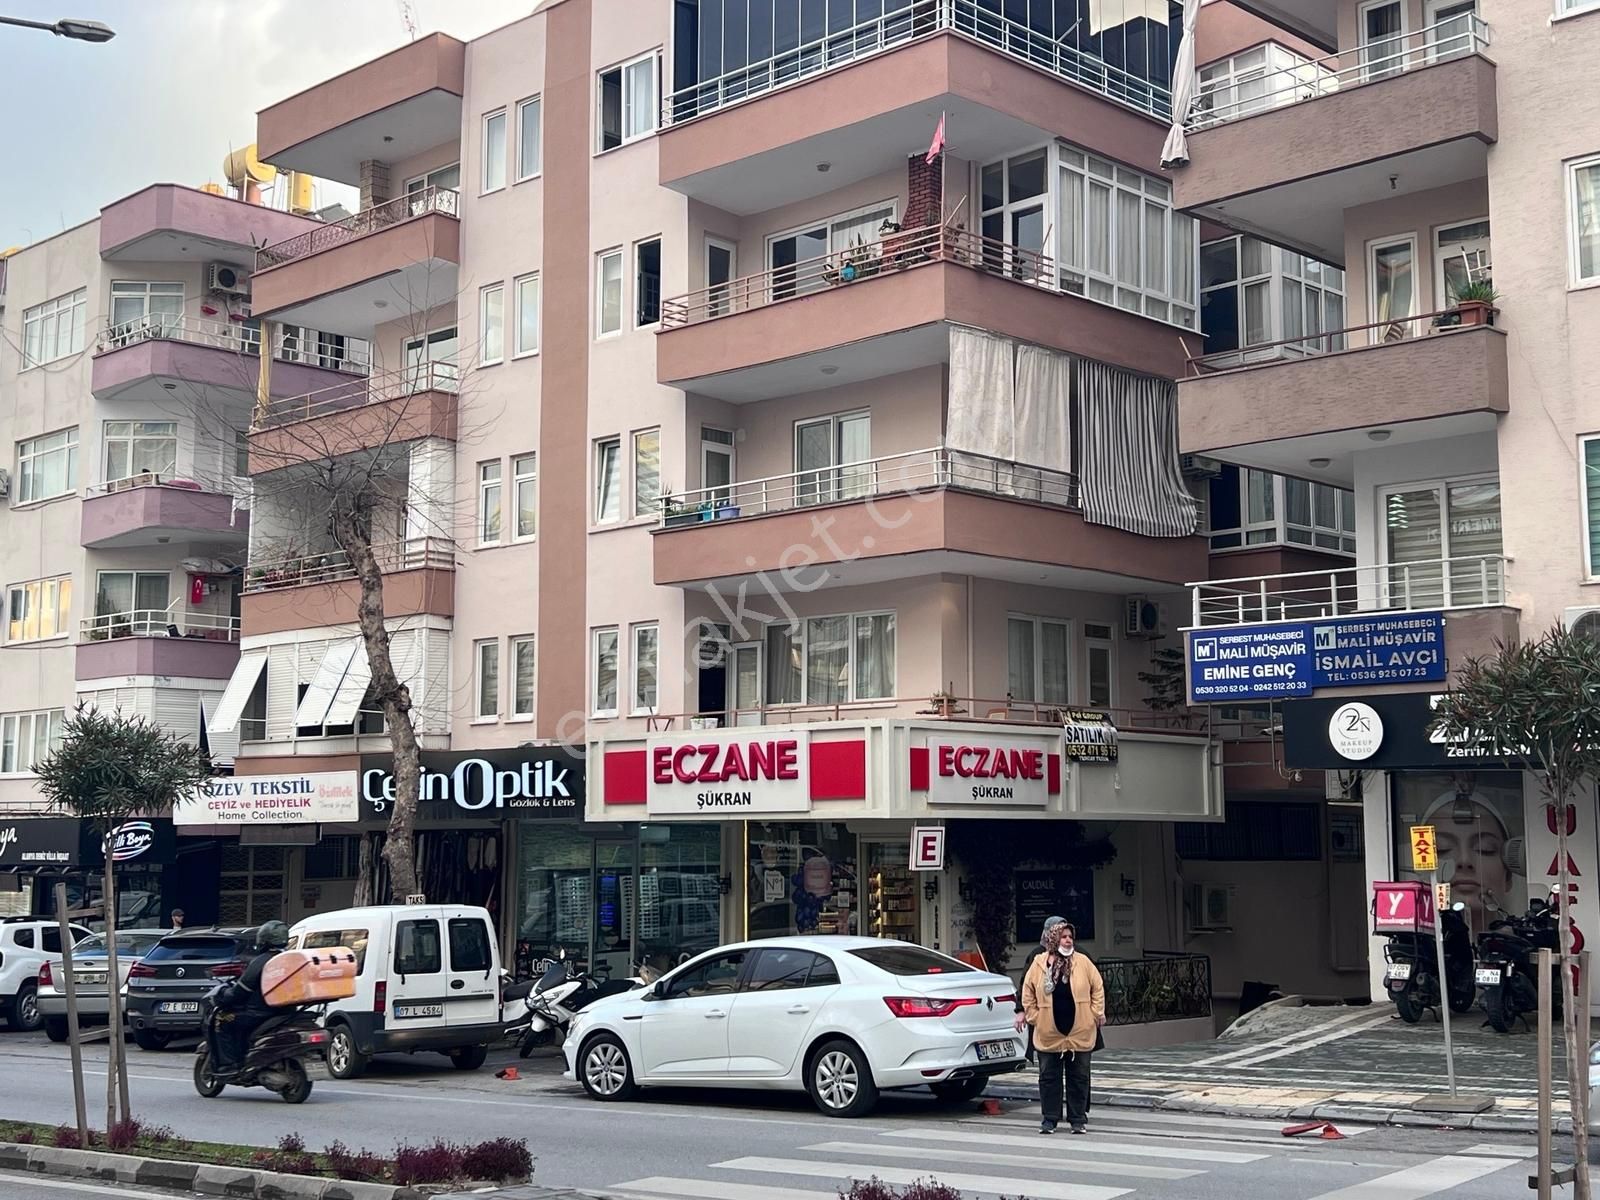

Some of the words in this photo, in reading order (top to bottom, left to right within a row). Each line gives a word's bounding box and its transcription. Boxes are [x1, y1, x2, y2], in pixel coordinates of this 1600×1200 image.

[1337, 623, 1376, 634] SERBEST
[1377, 618, 1436, 631] MUHASEBECİ
[1220, 634, 1252, 645] SERBEST
[1253, 630, 1304, 642] MUHASEBECİ
[1338, 633, 1371, 648] MALİ
[1373, 629, 1436, 646] MÜŞAVİR
[1220, 645, 1249, 660] MALİ
[1251, 642, 1306, 659] MÜŞAVİR
[1315, 650, 1384, 671] İSMAİL
[1204, 664, 1250, 680] EMİNE
[1252, 663, 1296, 680] GENÇ
[1328, 673, 1350, 682] TEL:
[1350, 671, 1377, 680] 0536
[1378, 669, 1398, 678] 925
[1399, 668, 1412, 677] 07
[1413, 667, 1427, 676] 23
[1195, 686, 1214, 695] 0530
[1214, 684, 1229, 694] 320
[1229, 684, 1239, 692] 52
[1239, 683, 1249, 692] 04
[1254, 682, 1273, 692] 0242
[1274, 681, 1286, 690] 512
[1286, 681, 1296, 690] 20
[1296, 681, 1307, 689] 33
[1066, 726, 1105, 744] SATILIK
[1340, 739, 1373, 747] MAKEUP
[1067, 744, 1087, 756] 0532
[1087, 745, 1099, 756] 471
[653, 739, 799, 785] ECZANE
[938, 745, 1044, 780] ECZANE
[250, 777, 315, 796] TEKSTİL
[363, 764, 449, 812] Çein
[449, 758, 571, 810] Optik
[972, 785, 1013, 800] ŞÜKRAN
[207, 800, 237, 810] CEYİZ
[239, 801, 252, 809] ve
[254, 798, 312, 809] HEDİYELİK
[552, 798, 576, 807] Lens
[697, 790, 752, 809] ŞÜKRAN
[217, 811, 247, 820] Home
[251, 809, 303, 820] Collection
[126, 831, 152, 848] Boya
[1413, 830, 1432, 863] TAXI
[921, 836, 937, 861] E
[400, 1007, 409, 1017] 07
[413, 1007, 418, 1016] L
